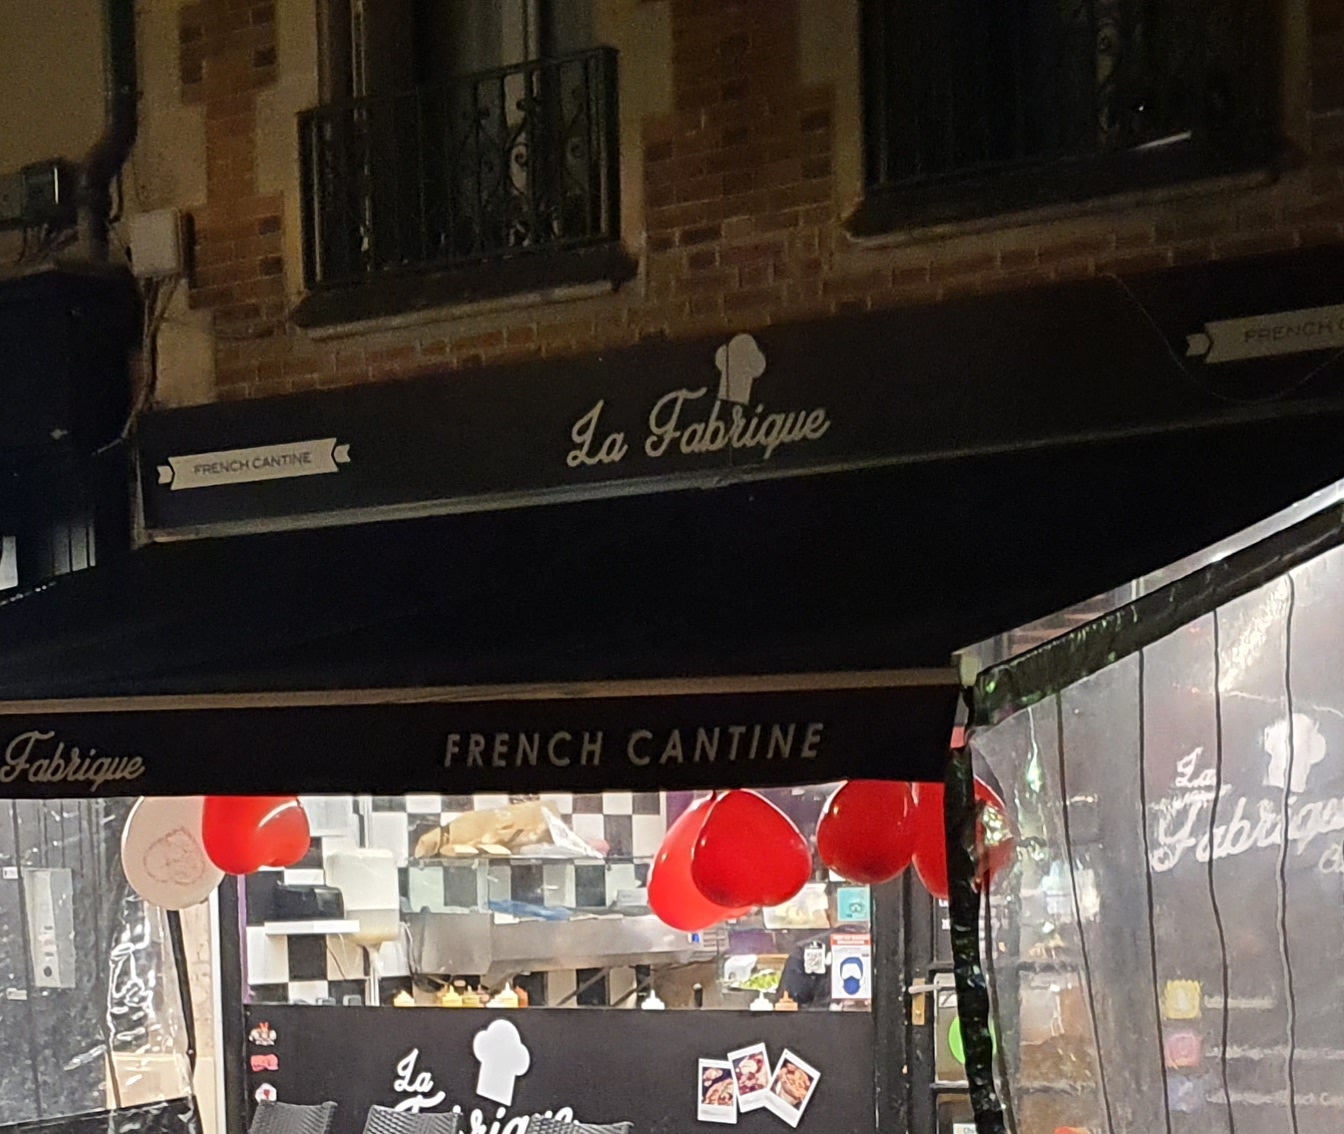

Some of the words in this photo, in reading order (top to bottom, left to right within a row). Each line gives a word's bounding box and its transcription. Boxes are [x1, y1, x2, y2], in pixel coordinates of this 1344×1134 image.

[1244, 321, 1333, 343] FRENCH
[565, 398, 629, 468] La
[644, 386, 831, 460] Fabrique
[193, 459, 250, 475] FRENCH
[251, 451, 312, 469] CANTINE
[443, 730, 604, 768] FRENCH
[626, 722, 825, 765] CANTINE
[1174, 746, 1218, 788] La
[393, 1047, 434, 1093] La
